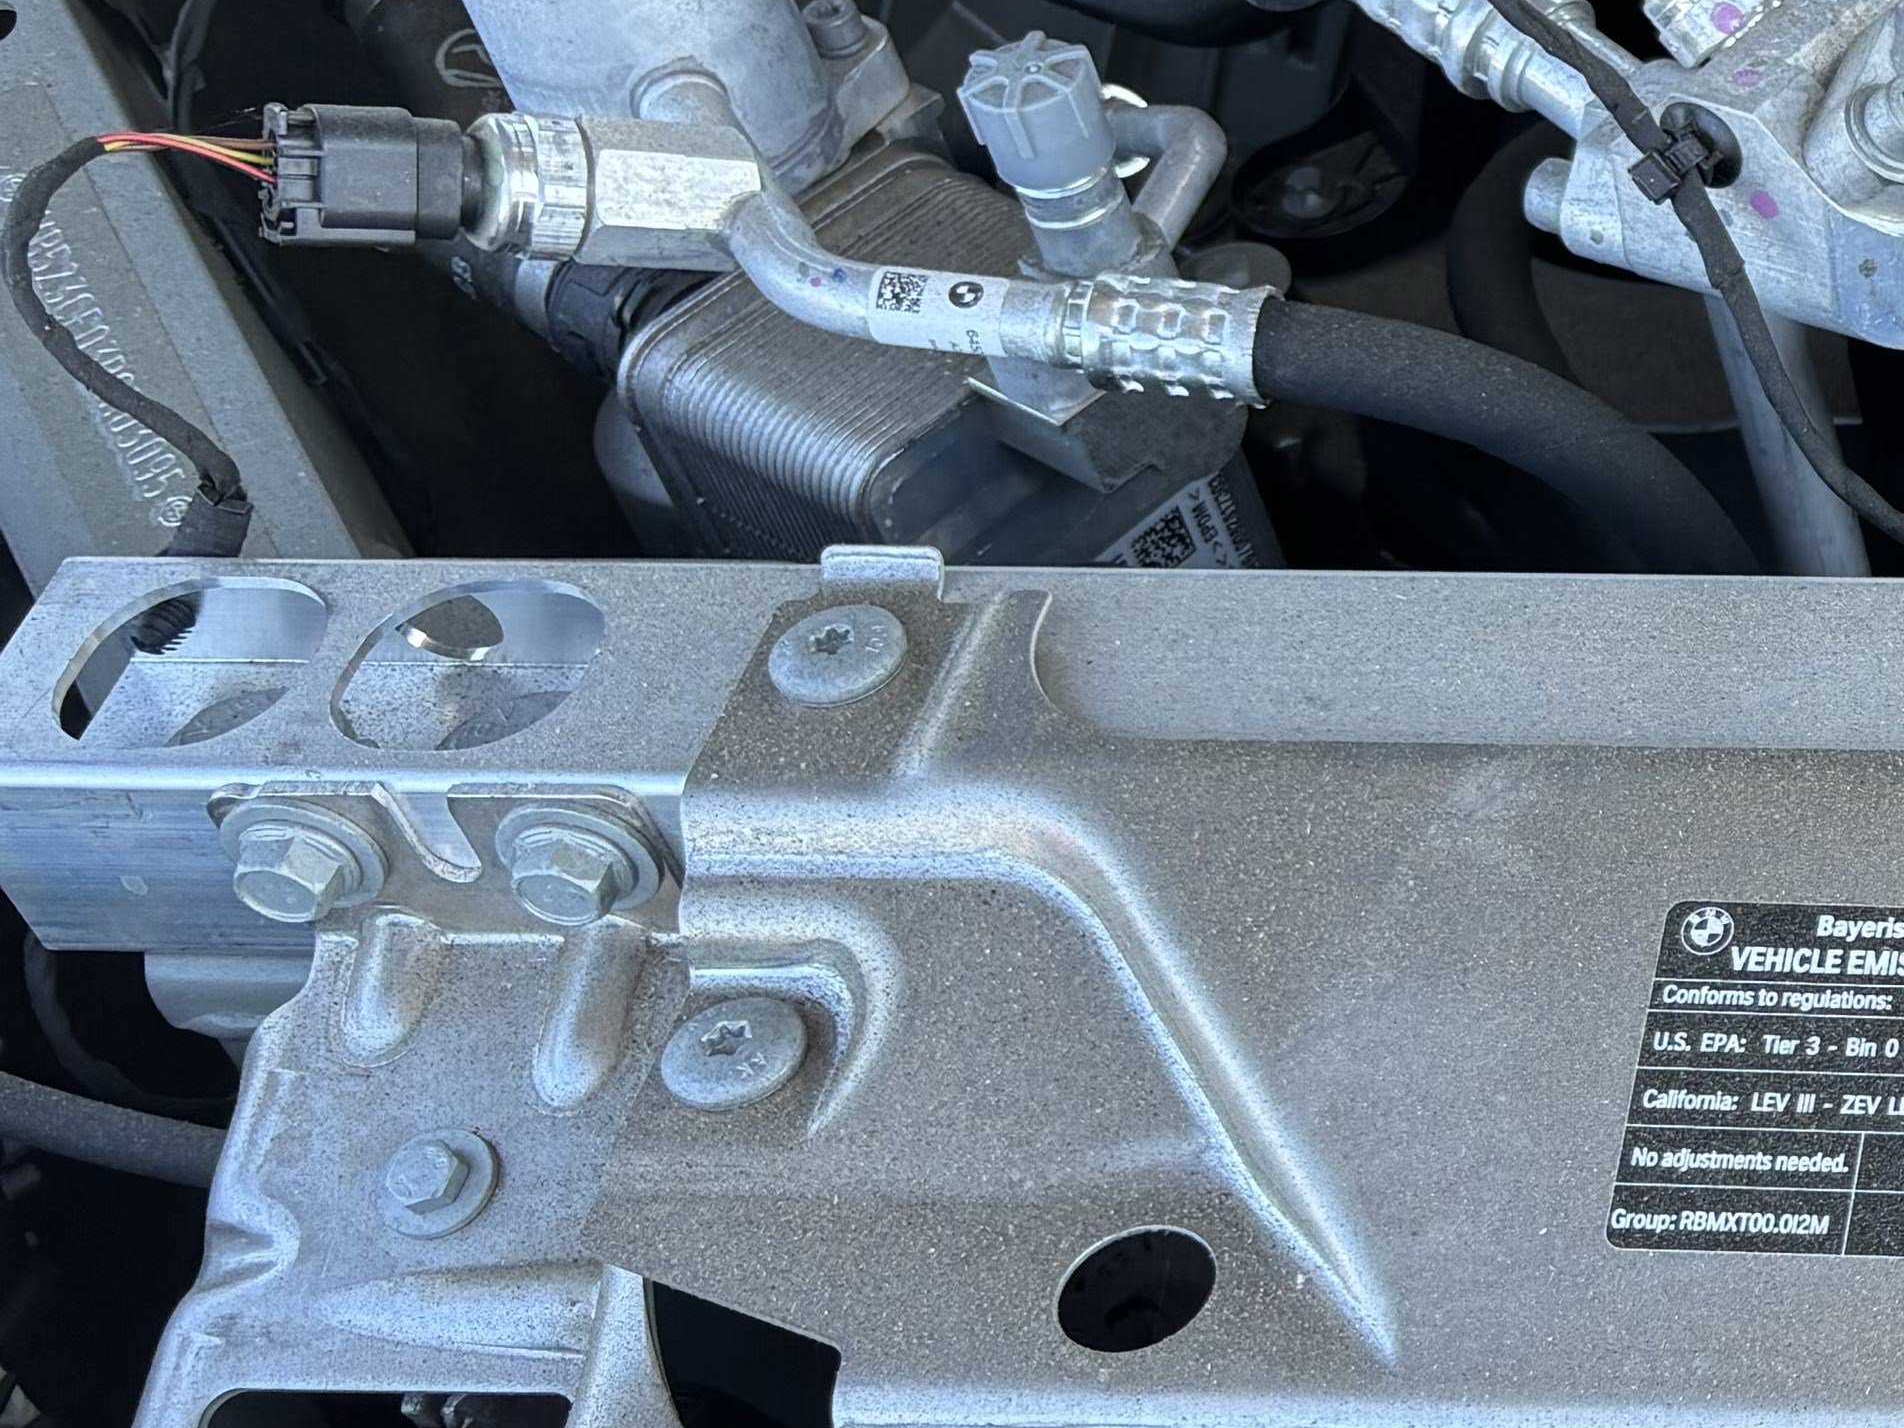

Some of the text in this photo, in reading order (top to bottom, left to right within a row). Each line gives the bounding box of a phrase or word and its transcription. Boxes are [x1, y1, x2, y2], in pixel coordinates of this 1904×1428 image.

[1731, 946, 1843, 976] VEHICLE
[1662, 984, 1893, 1011] Conforms to regulations:
[1653, 1032, 1691, 1053] U.S.
[1701, 1033, 1746, 1054] EPA:
[1763, 1034, 1799, 1055] Tier
[1805, 1036, 1819, 1056] 3
[1844, 1037, 1876, 1057] Bin
[1885, 1038, 1899, 1058] 0
[1643, 1089, 1737, 1111] California:
[1751, 1092, 1788, 1112] LEV
[1797, 1093, 1815, 1114] III
[1841, 1094, 1881, 1115] ZEV
[1631, 1146, 1848, 1172] No adjustments needed.
[1610, 1209, 1676, 1233] Group:
